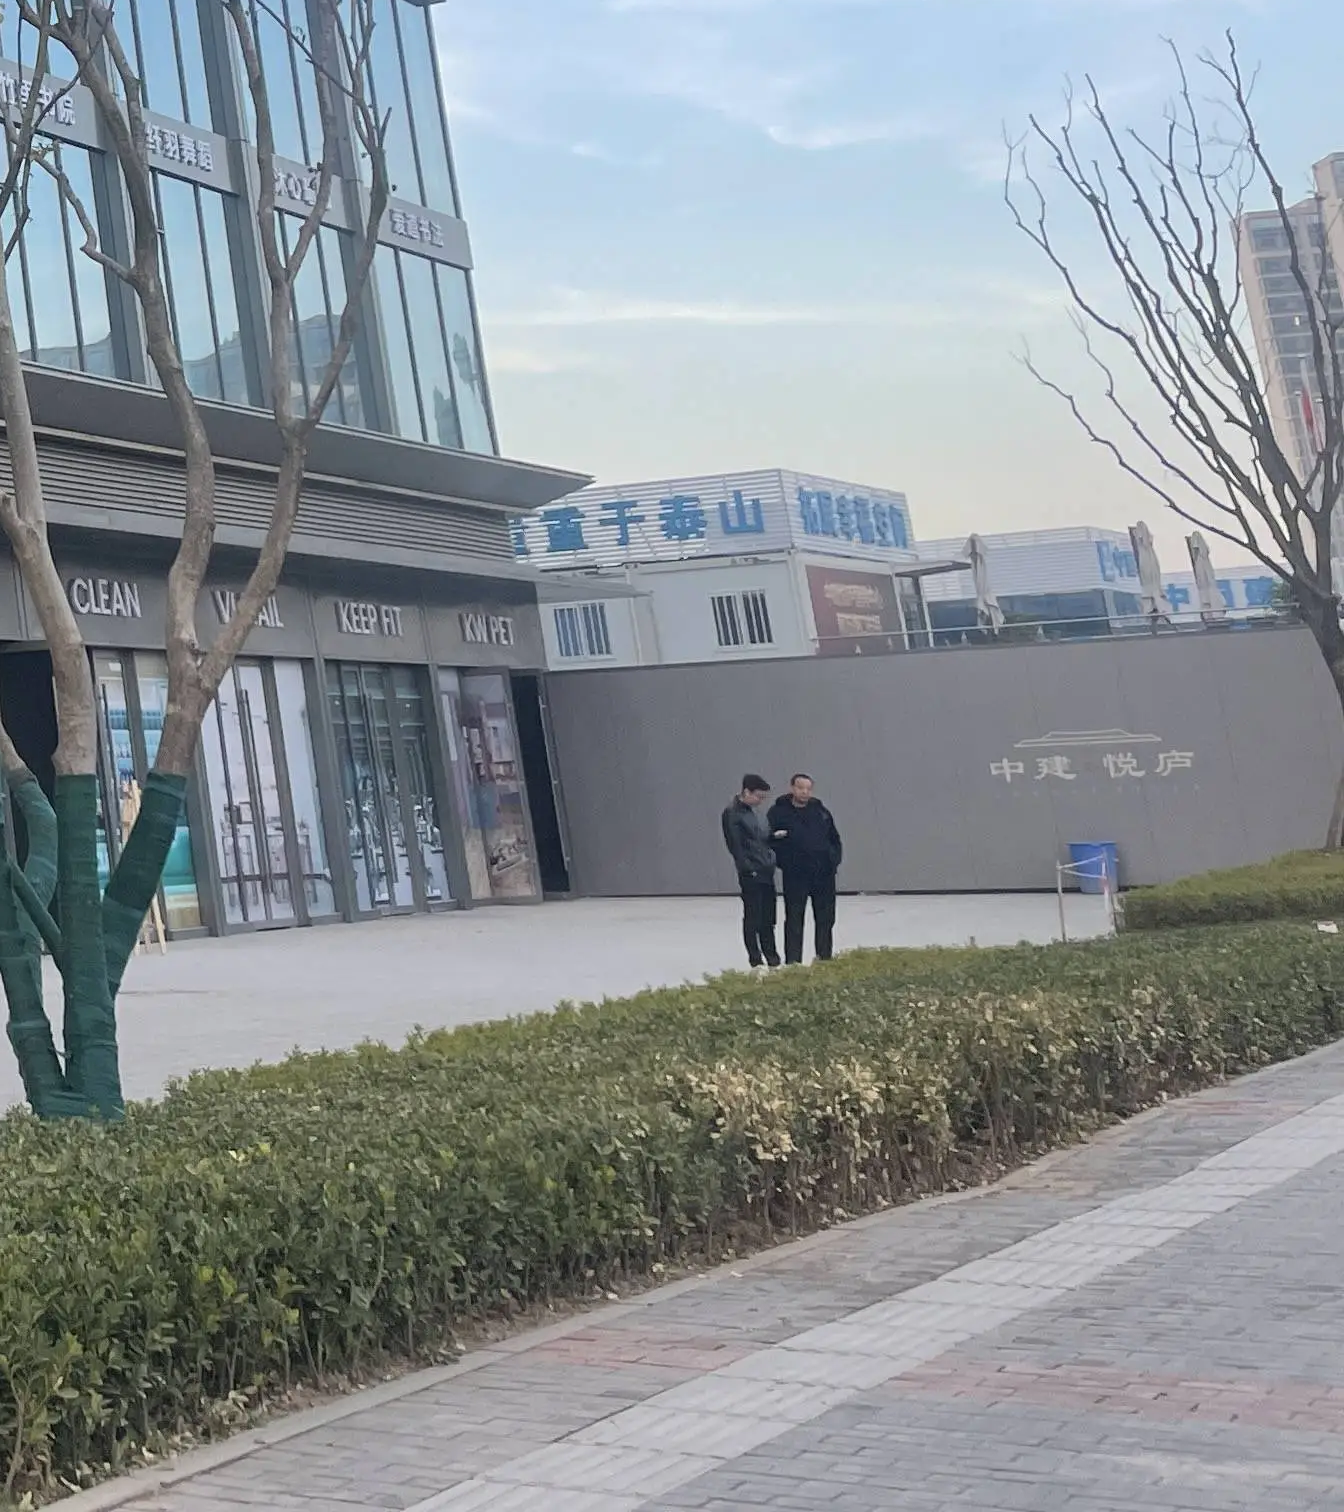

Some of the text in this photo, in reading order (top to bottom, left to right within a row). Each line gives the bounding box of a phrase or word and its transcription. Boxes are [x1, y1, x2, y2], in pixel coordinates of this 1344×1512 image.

[69, 577, 142, 619] CLEAN
[336, 599, 404, 637] KEEP FIT
[489, 615, 515, 646] PET
[989, 749, 1195, 783] 中建 悦庐
